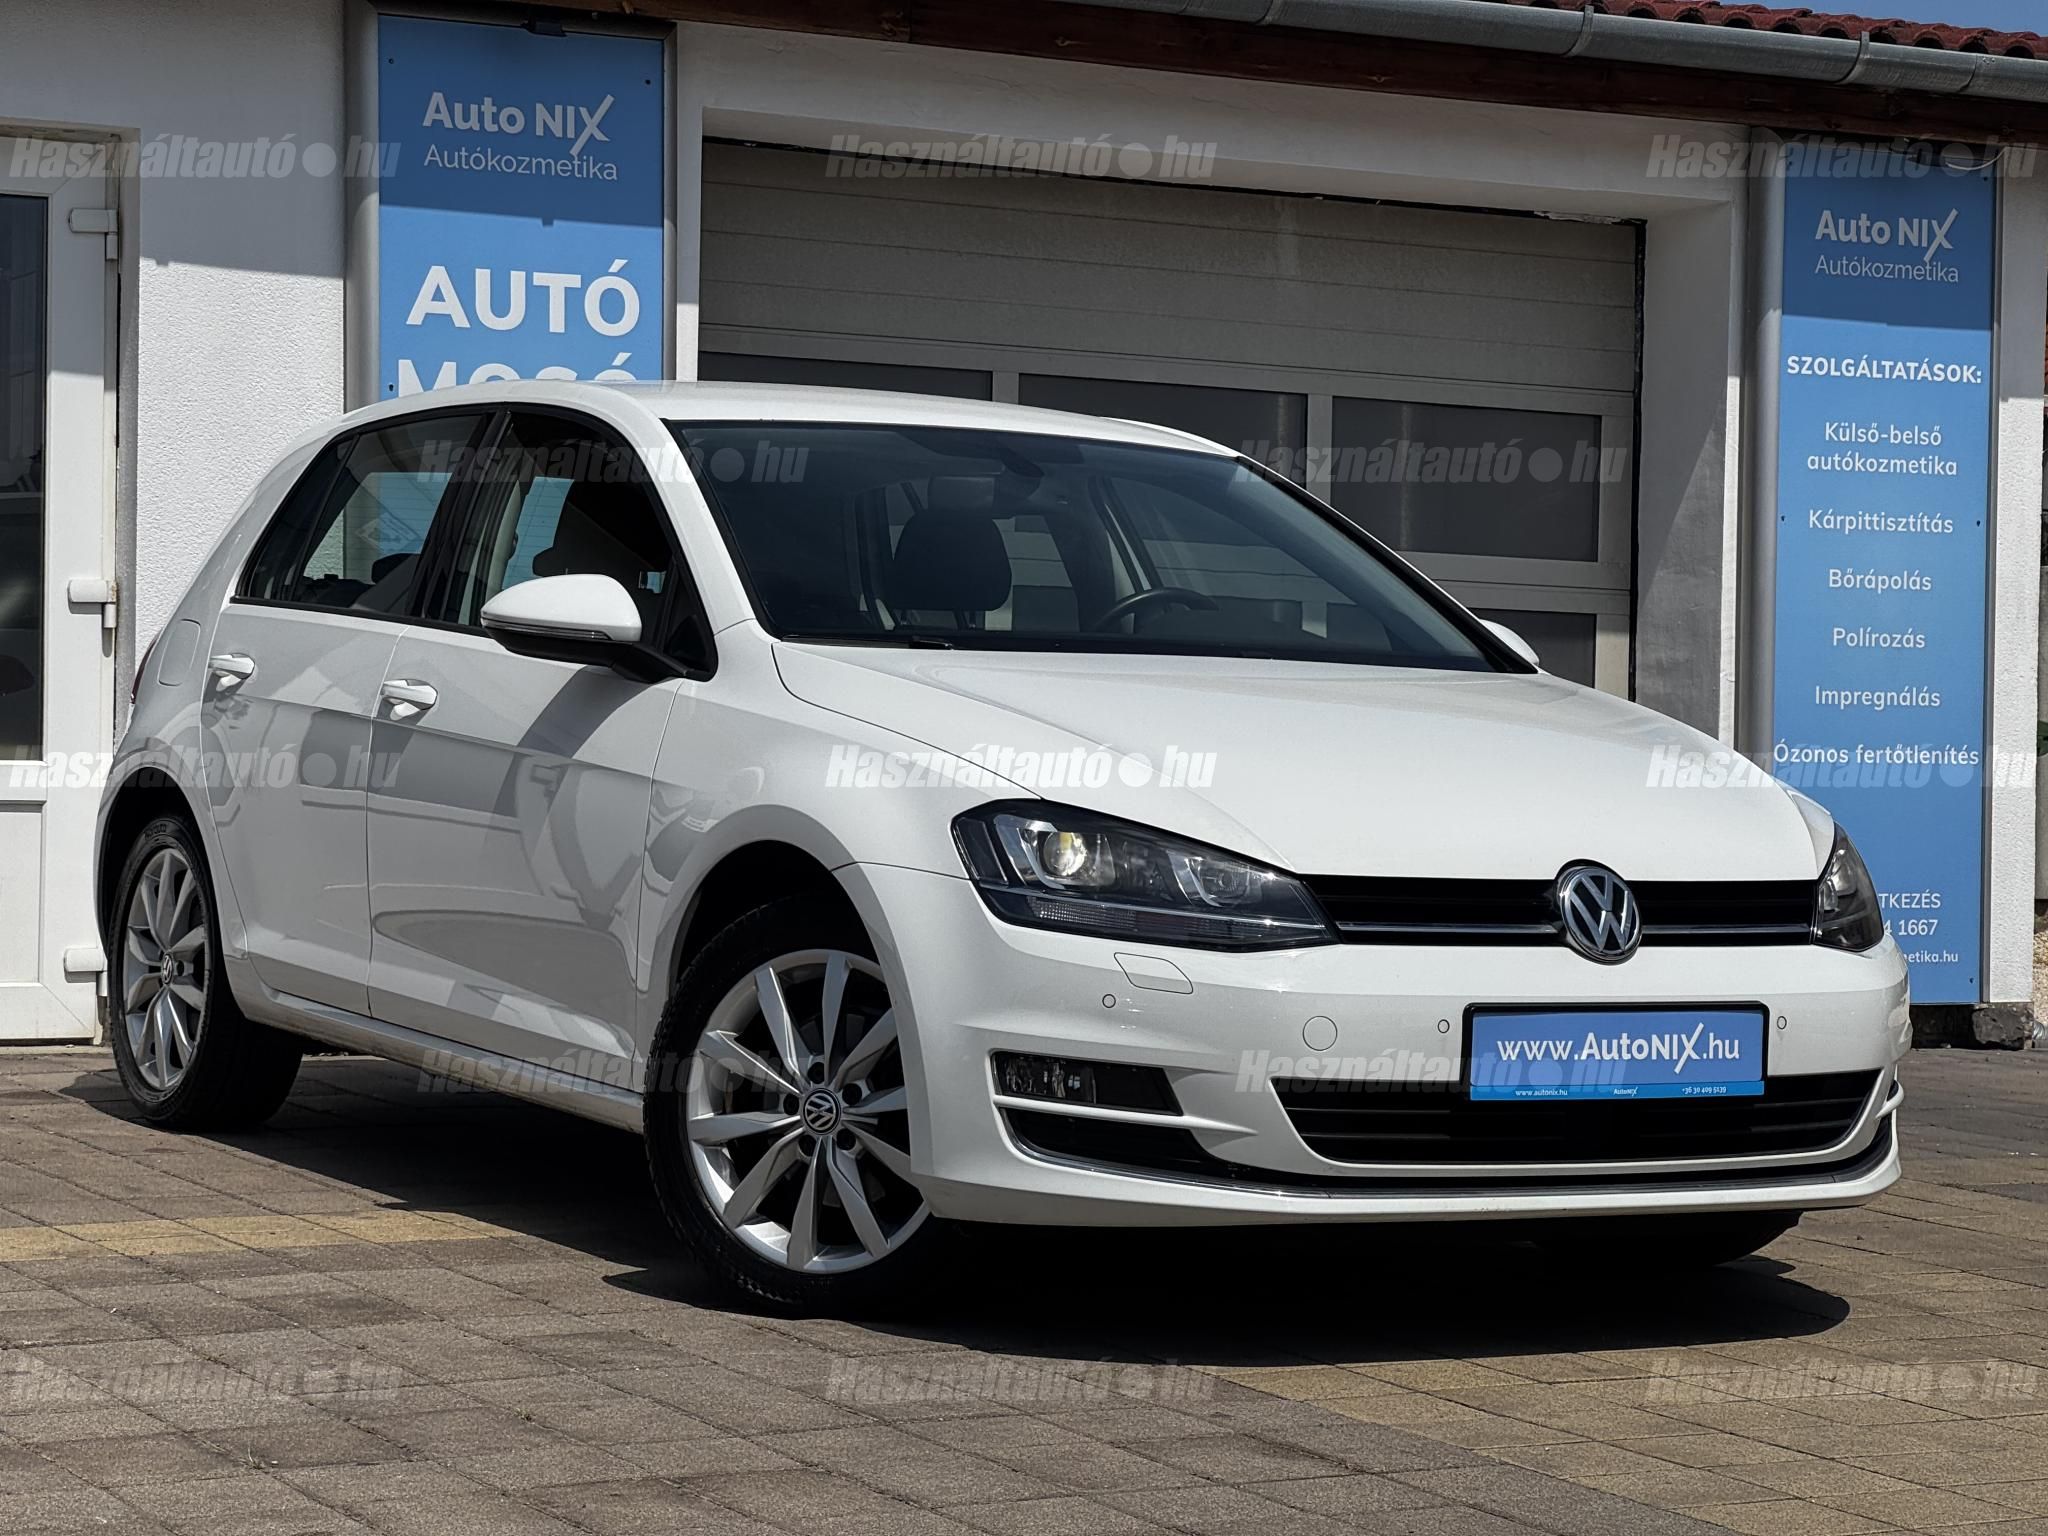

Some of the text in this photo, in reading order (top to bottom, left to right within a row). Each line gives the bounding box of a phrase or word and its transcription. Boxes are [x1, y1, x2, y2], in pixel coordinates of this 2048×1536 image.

[422, 91, 617, 157] Auto NIX
[423, 144, 619, 182] Autókozmetika
[1815, 208, 1959, 262] Auto NIX
[1814, 255, 1960, 283] Autókozmetika
[405, 258, 641, 337] AUTÓ
[1787, 354, 1982, 384] SZOLGÁLTATÁSOK:
[1824, 422, 1942, 447] Külső-belső
[1807, 451, 1958, 477] autókozmetika
[1808, 509, 1954, 535] Kárpittisztítás
[1828, 568, 1932, 594] Bőrápolás
[1832, 627, 1926, 650] Polírozás
[1815, 685, 1941, 712] Impregnálás
[1773, 738, 1980, 766] Ózonos fertőtlenítés
[1878, 888, 1941, 909] TKEZÉS
[1898, 919, 1939, 936] 1667
[1904, 950, 1959, 963] etika.hu
[1497, 1022, 1740, 1075] www.AutoNIX.hu
[1515, 1088, 1568, 1097] www.autonix.hu
